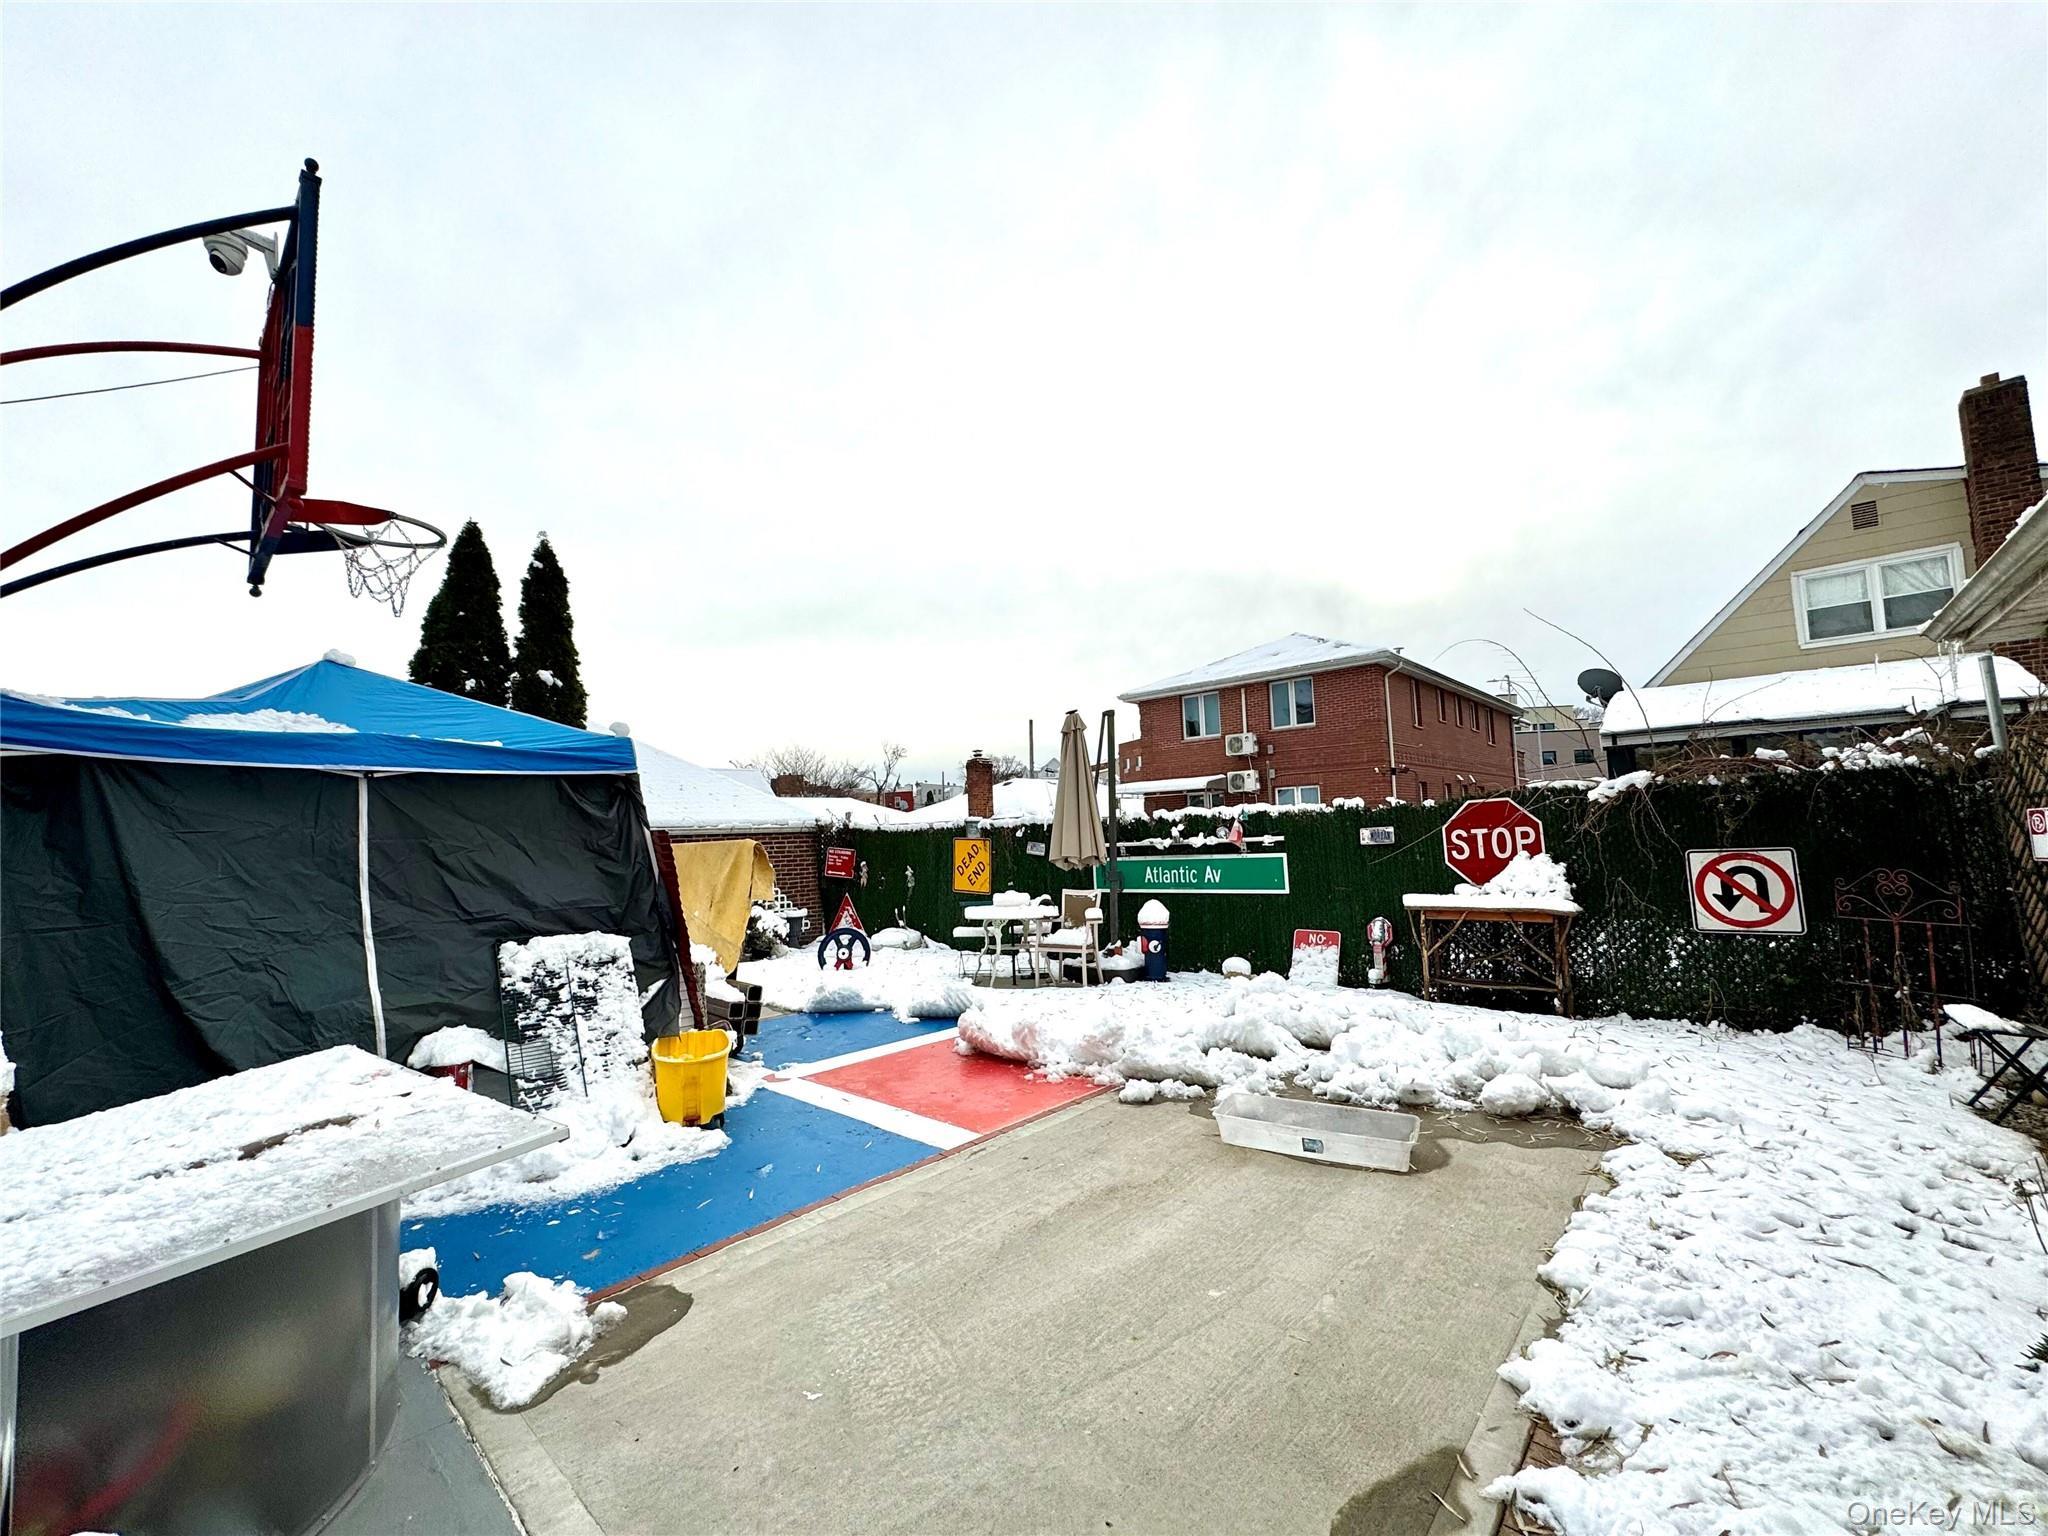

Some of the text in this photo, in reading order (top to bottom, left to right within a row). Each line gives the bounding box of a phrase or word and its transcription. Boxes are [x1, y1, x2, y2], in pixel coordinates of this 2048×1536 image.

[1450, 826, 1536, 860] STOP
[956, 844, 980, 876] DEAD
[967, 861, 986, 886] END
[1144, 865, 1222, 884] Atlantic Av
[1308, 933, 1326, 944] NO
